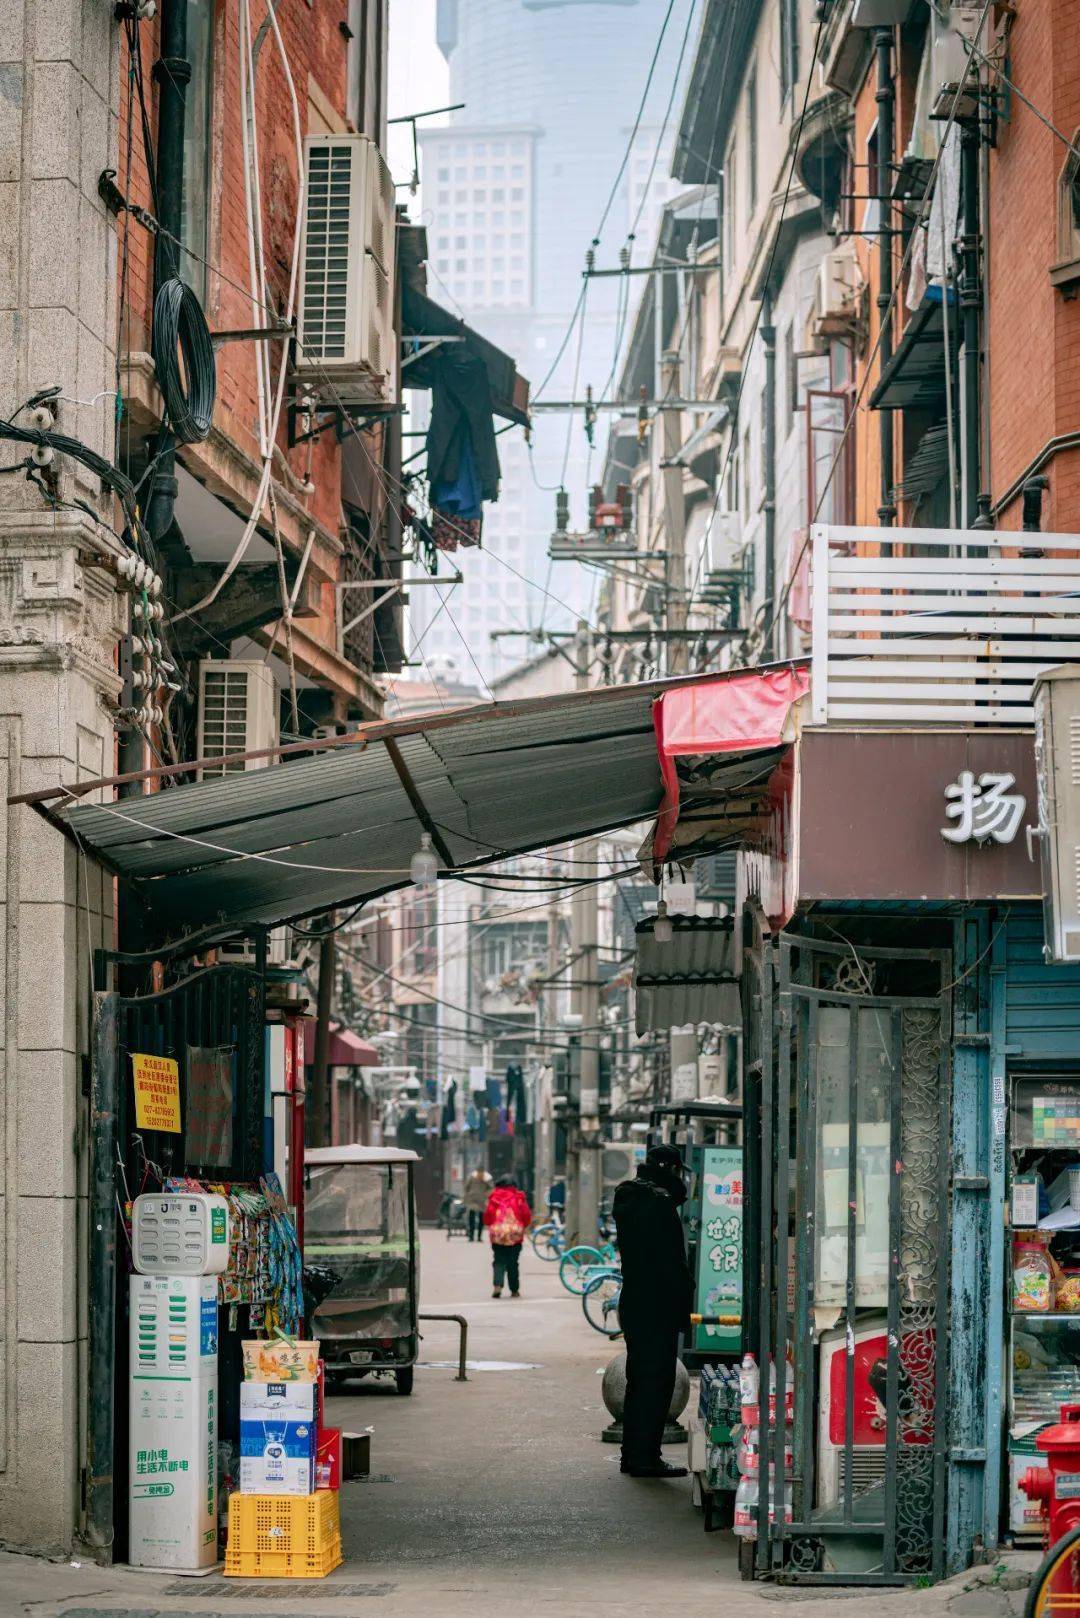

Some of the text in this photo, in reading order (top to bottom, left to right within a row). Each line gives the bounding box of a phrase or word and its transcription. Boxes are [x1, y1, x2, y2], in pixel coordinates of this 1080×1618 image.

[940, 770, 1027, 844] 扬
[136, 1449, 168, 1462] 用小电
[136, 1460, 189, 1475] 生活不断电
